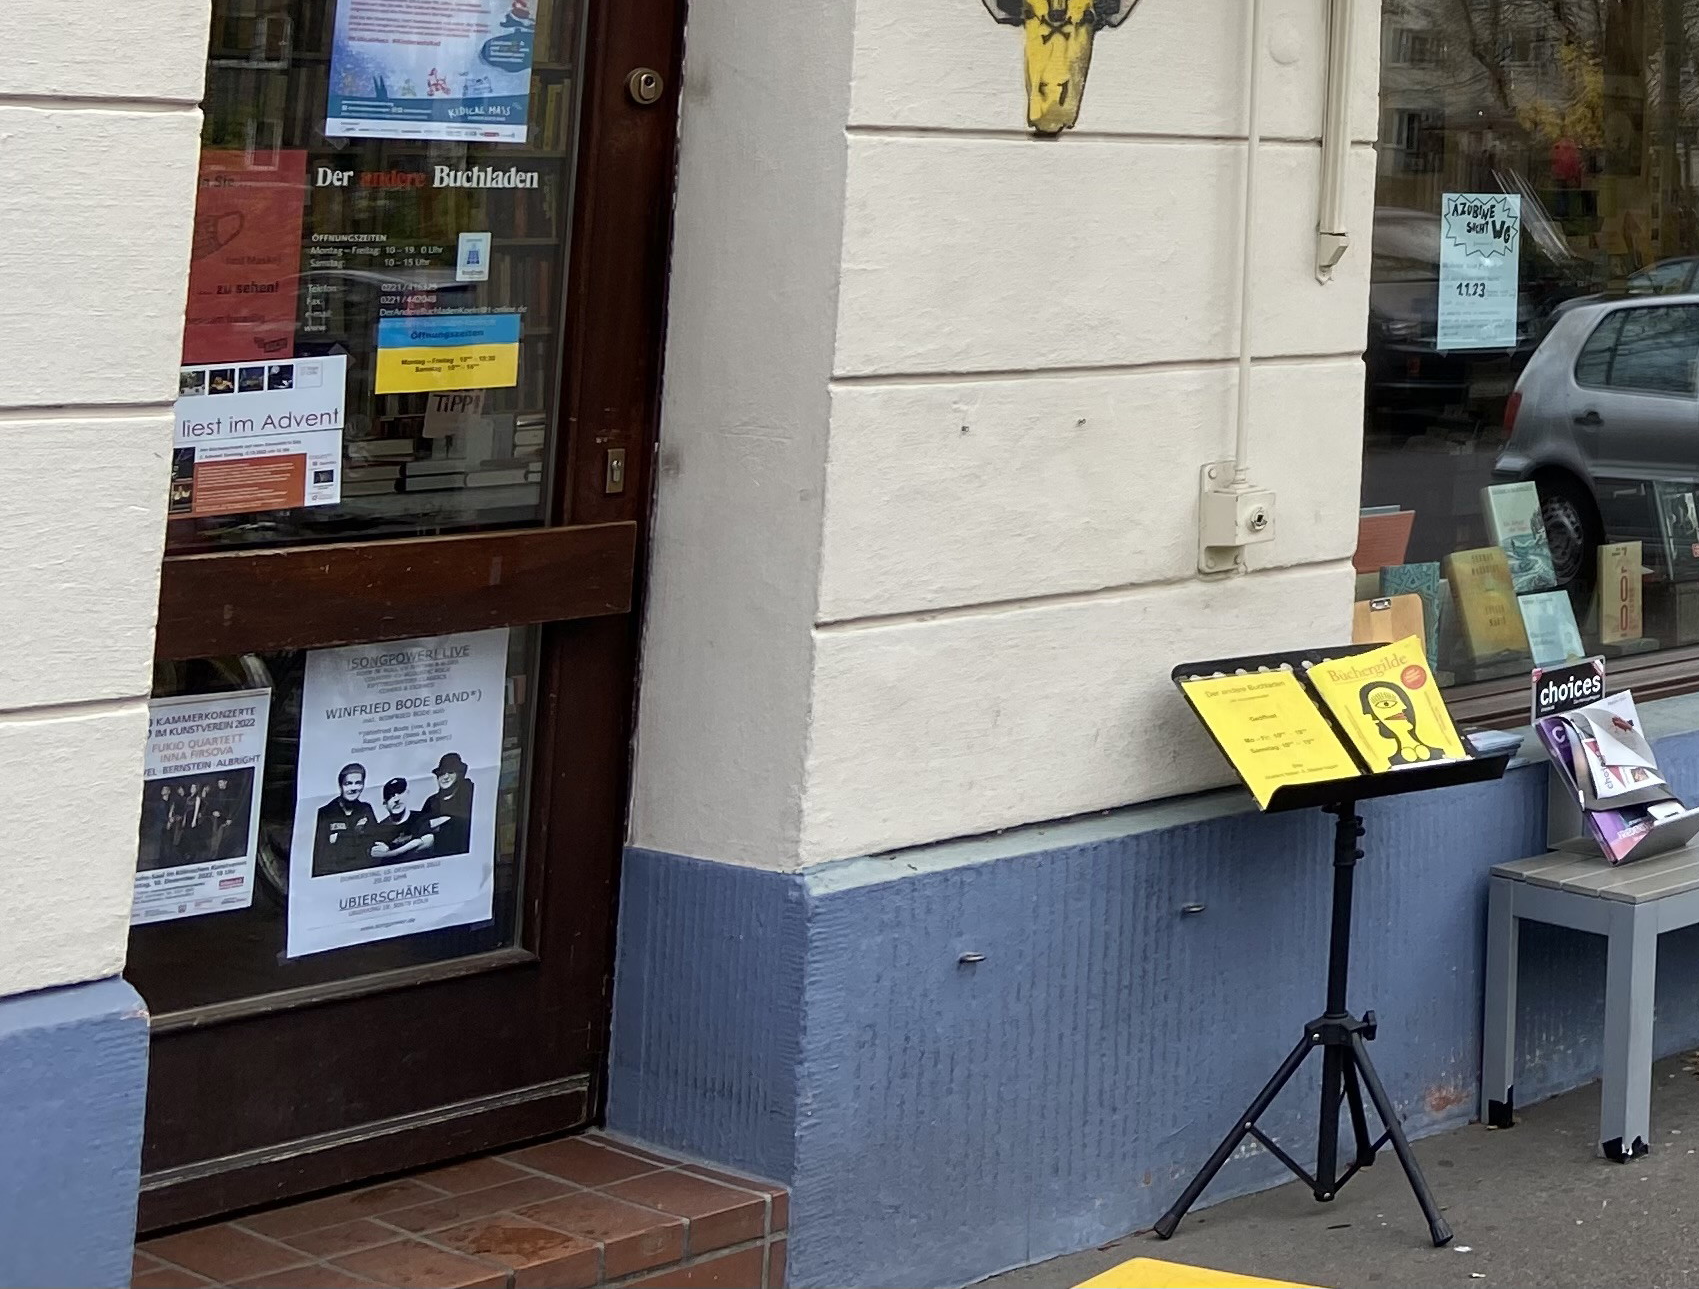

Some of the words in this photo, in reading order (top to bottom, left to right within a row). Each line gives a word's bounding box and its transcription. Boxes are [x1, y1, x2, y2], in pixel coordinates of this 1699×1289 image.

[316, 167, 353, 187] Der
[358, 169, 427, 187] andere
[433, 165, 538, 188] Buchladen
[1492, 220, 1511, 244] WG
[182, 418, 222, 438] liest
[229, 416, 254, 434] im
[261, 408, 339, 431] Advent
[443, 644, 470, 660] LIVE
[1540, 675, 1601, 706] choices
[155, 707, 256, 727] KAMMERKONZERTE
[325, 701, 391, 720] WINFRIED
[395, 696, 430, 711] BODE
[339, 881, 440, 910] UBIERSCHÄNKE
